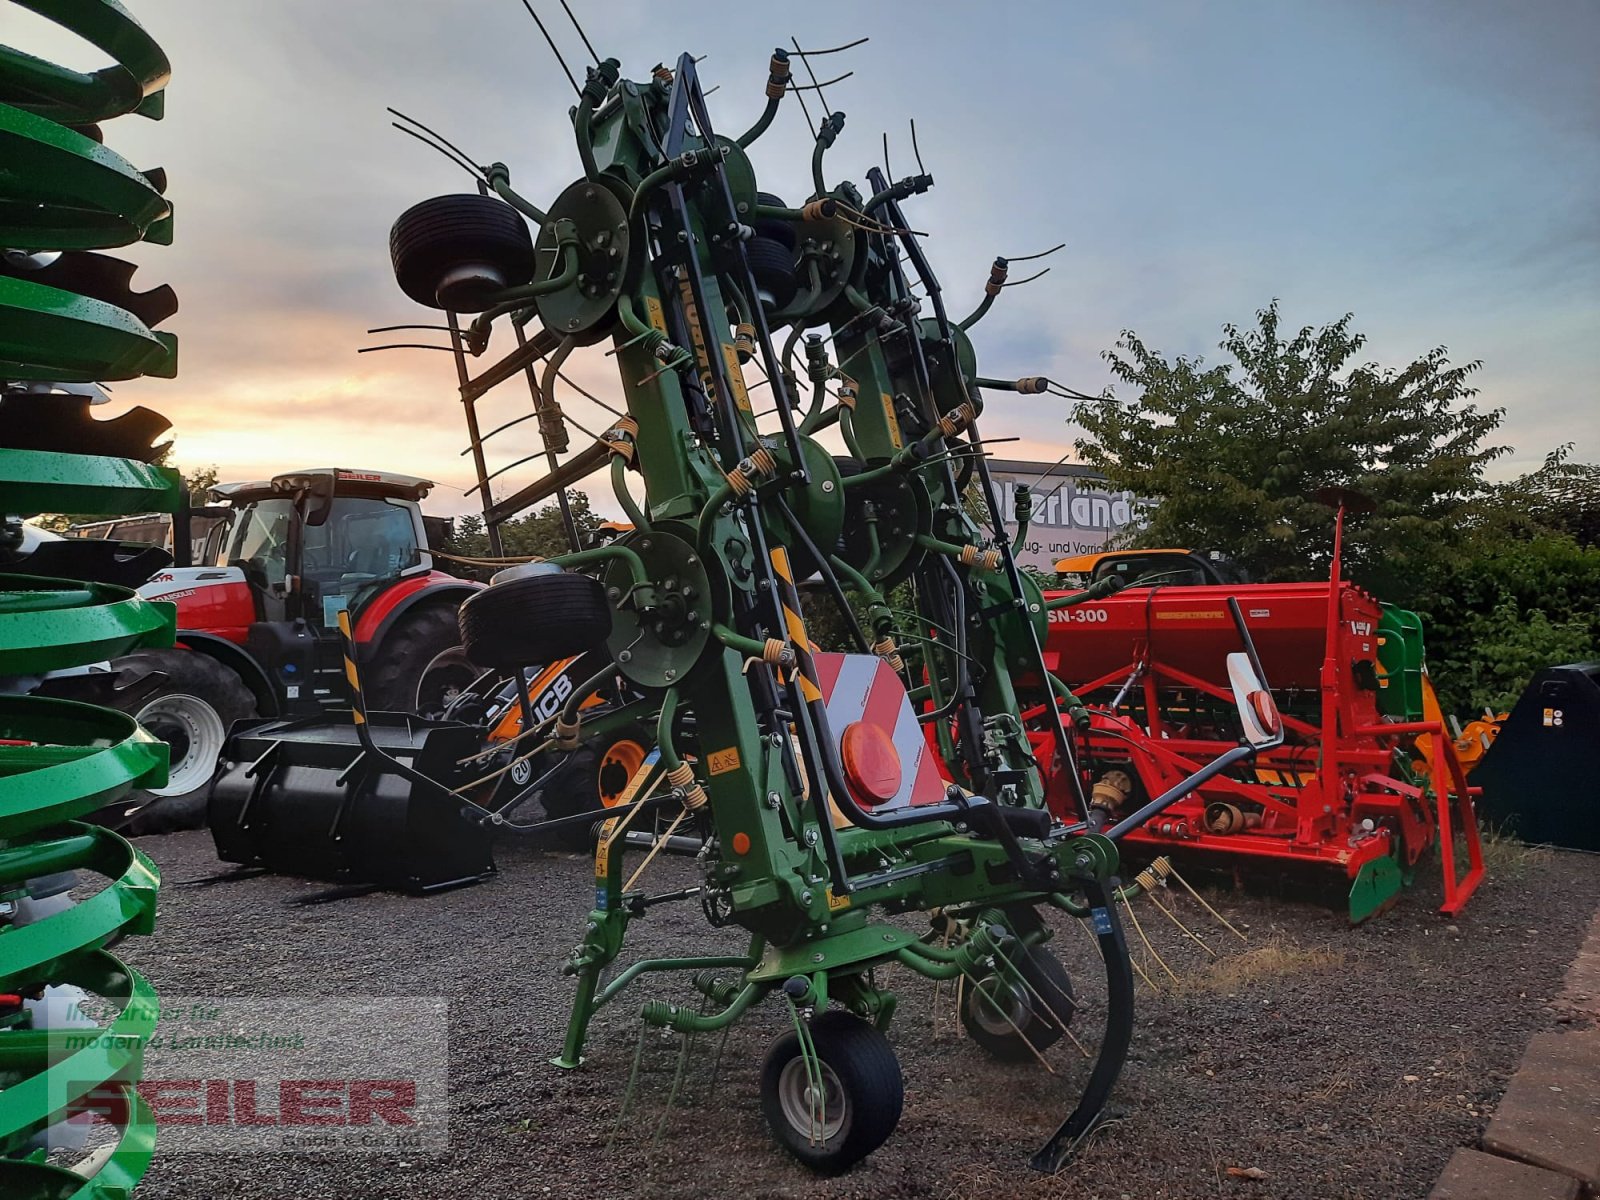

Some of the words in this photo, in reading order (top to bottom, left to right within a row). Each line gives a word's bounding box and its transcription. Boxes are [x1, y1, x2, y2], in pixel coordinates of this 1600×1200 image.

[336, 472, 382, 482] SEILER
[1048, 541, 1071, 553] und
[1047, 609, 1108, 623] SN-300
[534, 673, 573, 733] JCB
[514, 760, 529, 780] 20
